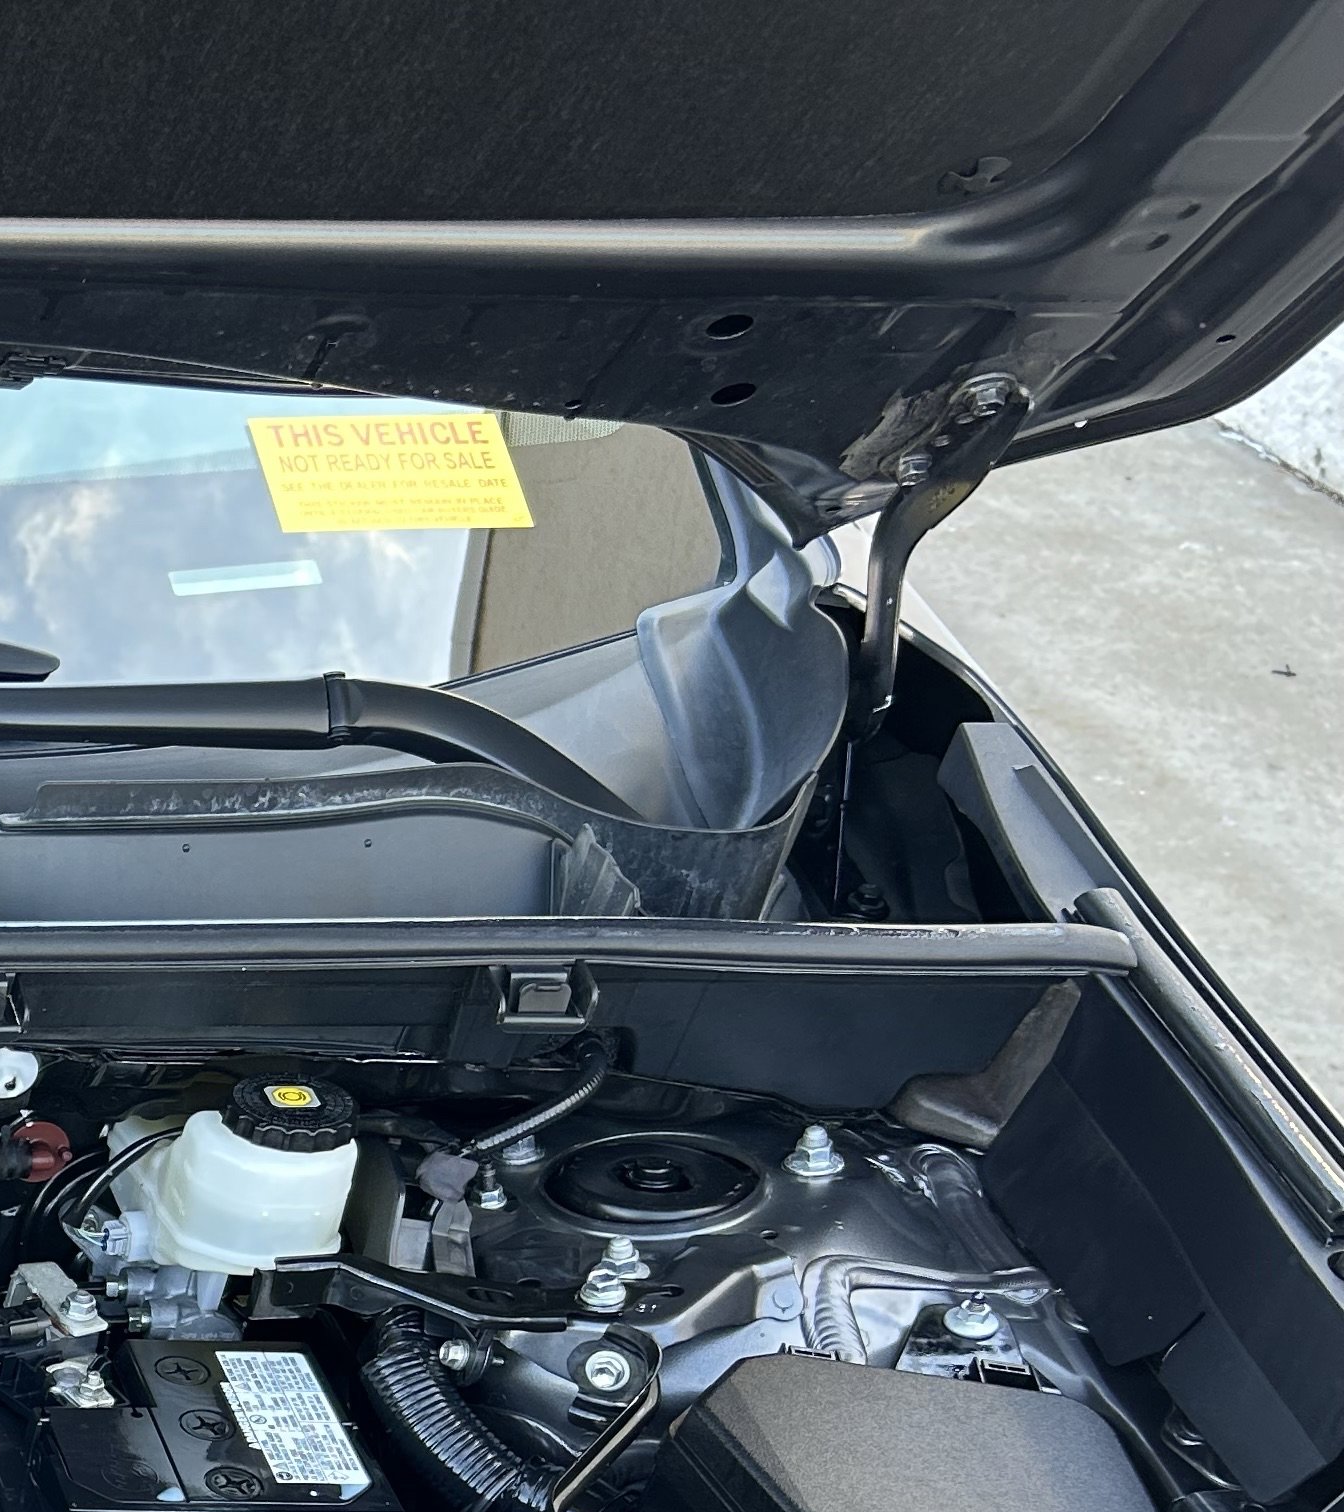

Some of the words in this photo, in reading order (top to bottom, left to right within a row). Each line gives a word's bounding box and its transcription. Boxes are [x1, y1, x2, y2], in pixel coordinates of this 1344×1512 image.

[267, 423, 344, 448] THIS
[350, 420, 490, 447] VEHICLE
[279, 453, 318, 473] NOT
[327, 452, 392, 472] READY
[398, 451, 438, 471] FOR
[447, 450, 495, 470] SALE
[424, 478, 471, 489] RESALE
[479, 477, 507, 488] DATE
